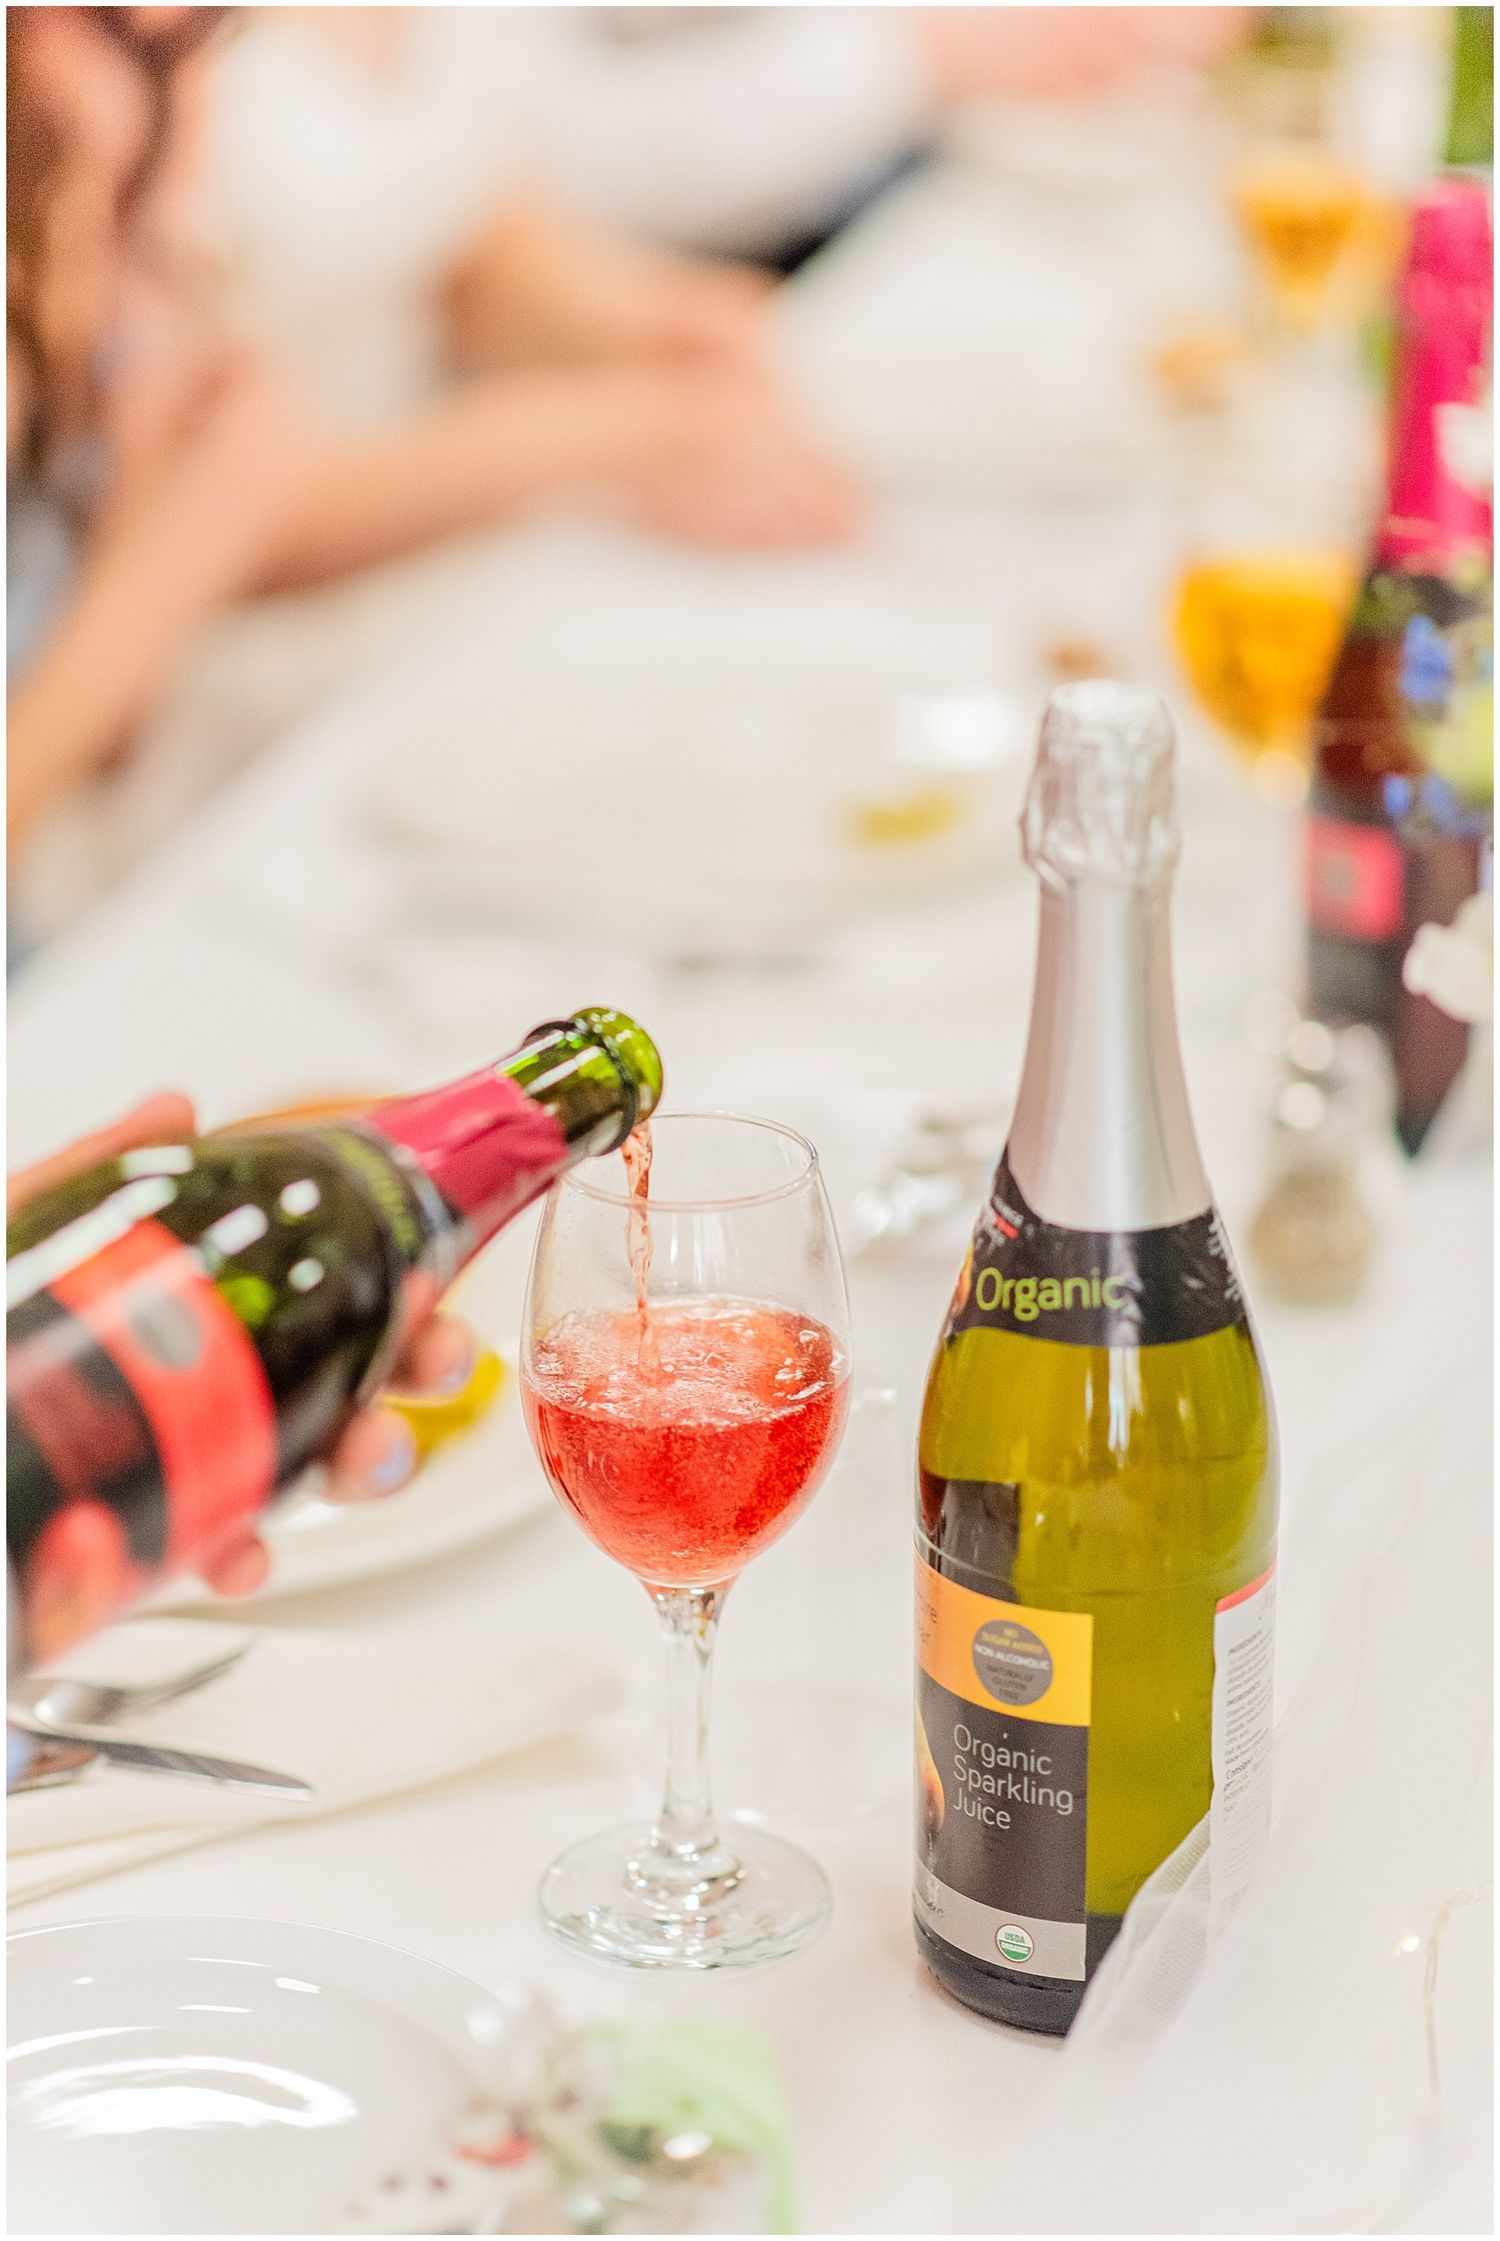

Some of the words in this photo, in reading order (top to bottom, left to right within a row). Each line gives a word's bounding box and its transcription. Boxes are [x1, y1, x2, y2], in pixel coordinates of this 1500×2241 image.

[975, 1267, 1129, 1322] Organic
[995, 1649, 1050, 1671] ALCOHOLIC
[953, 1724, 1052, 1775] Organic
[952, 1787, 1011, 1830] Juice
[953, 1754, 1073, 1816] Sparkling
[1004, 1931, 1025, 1944] USDA
